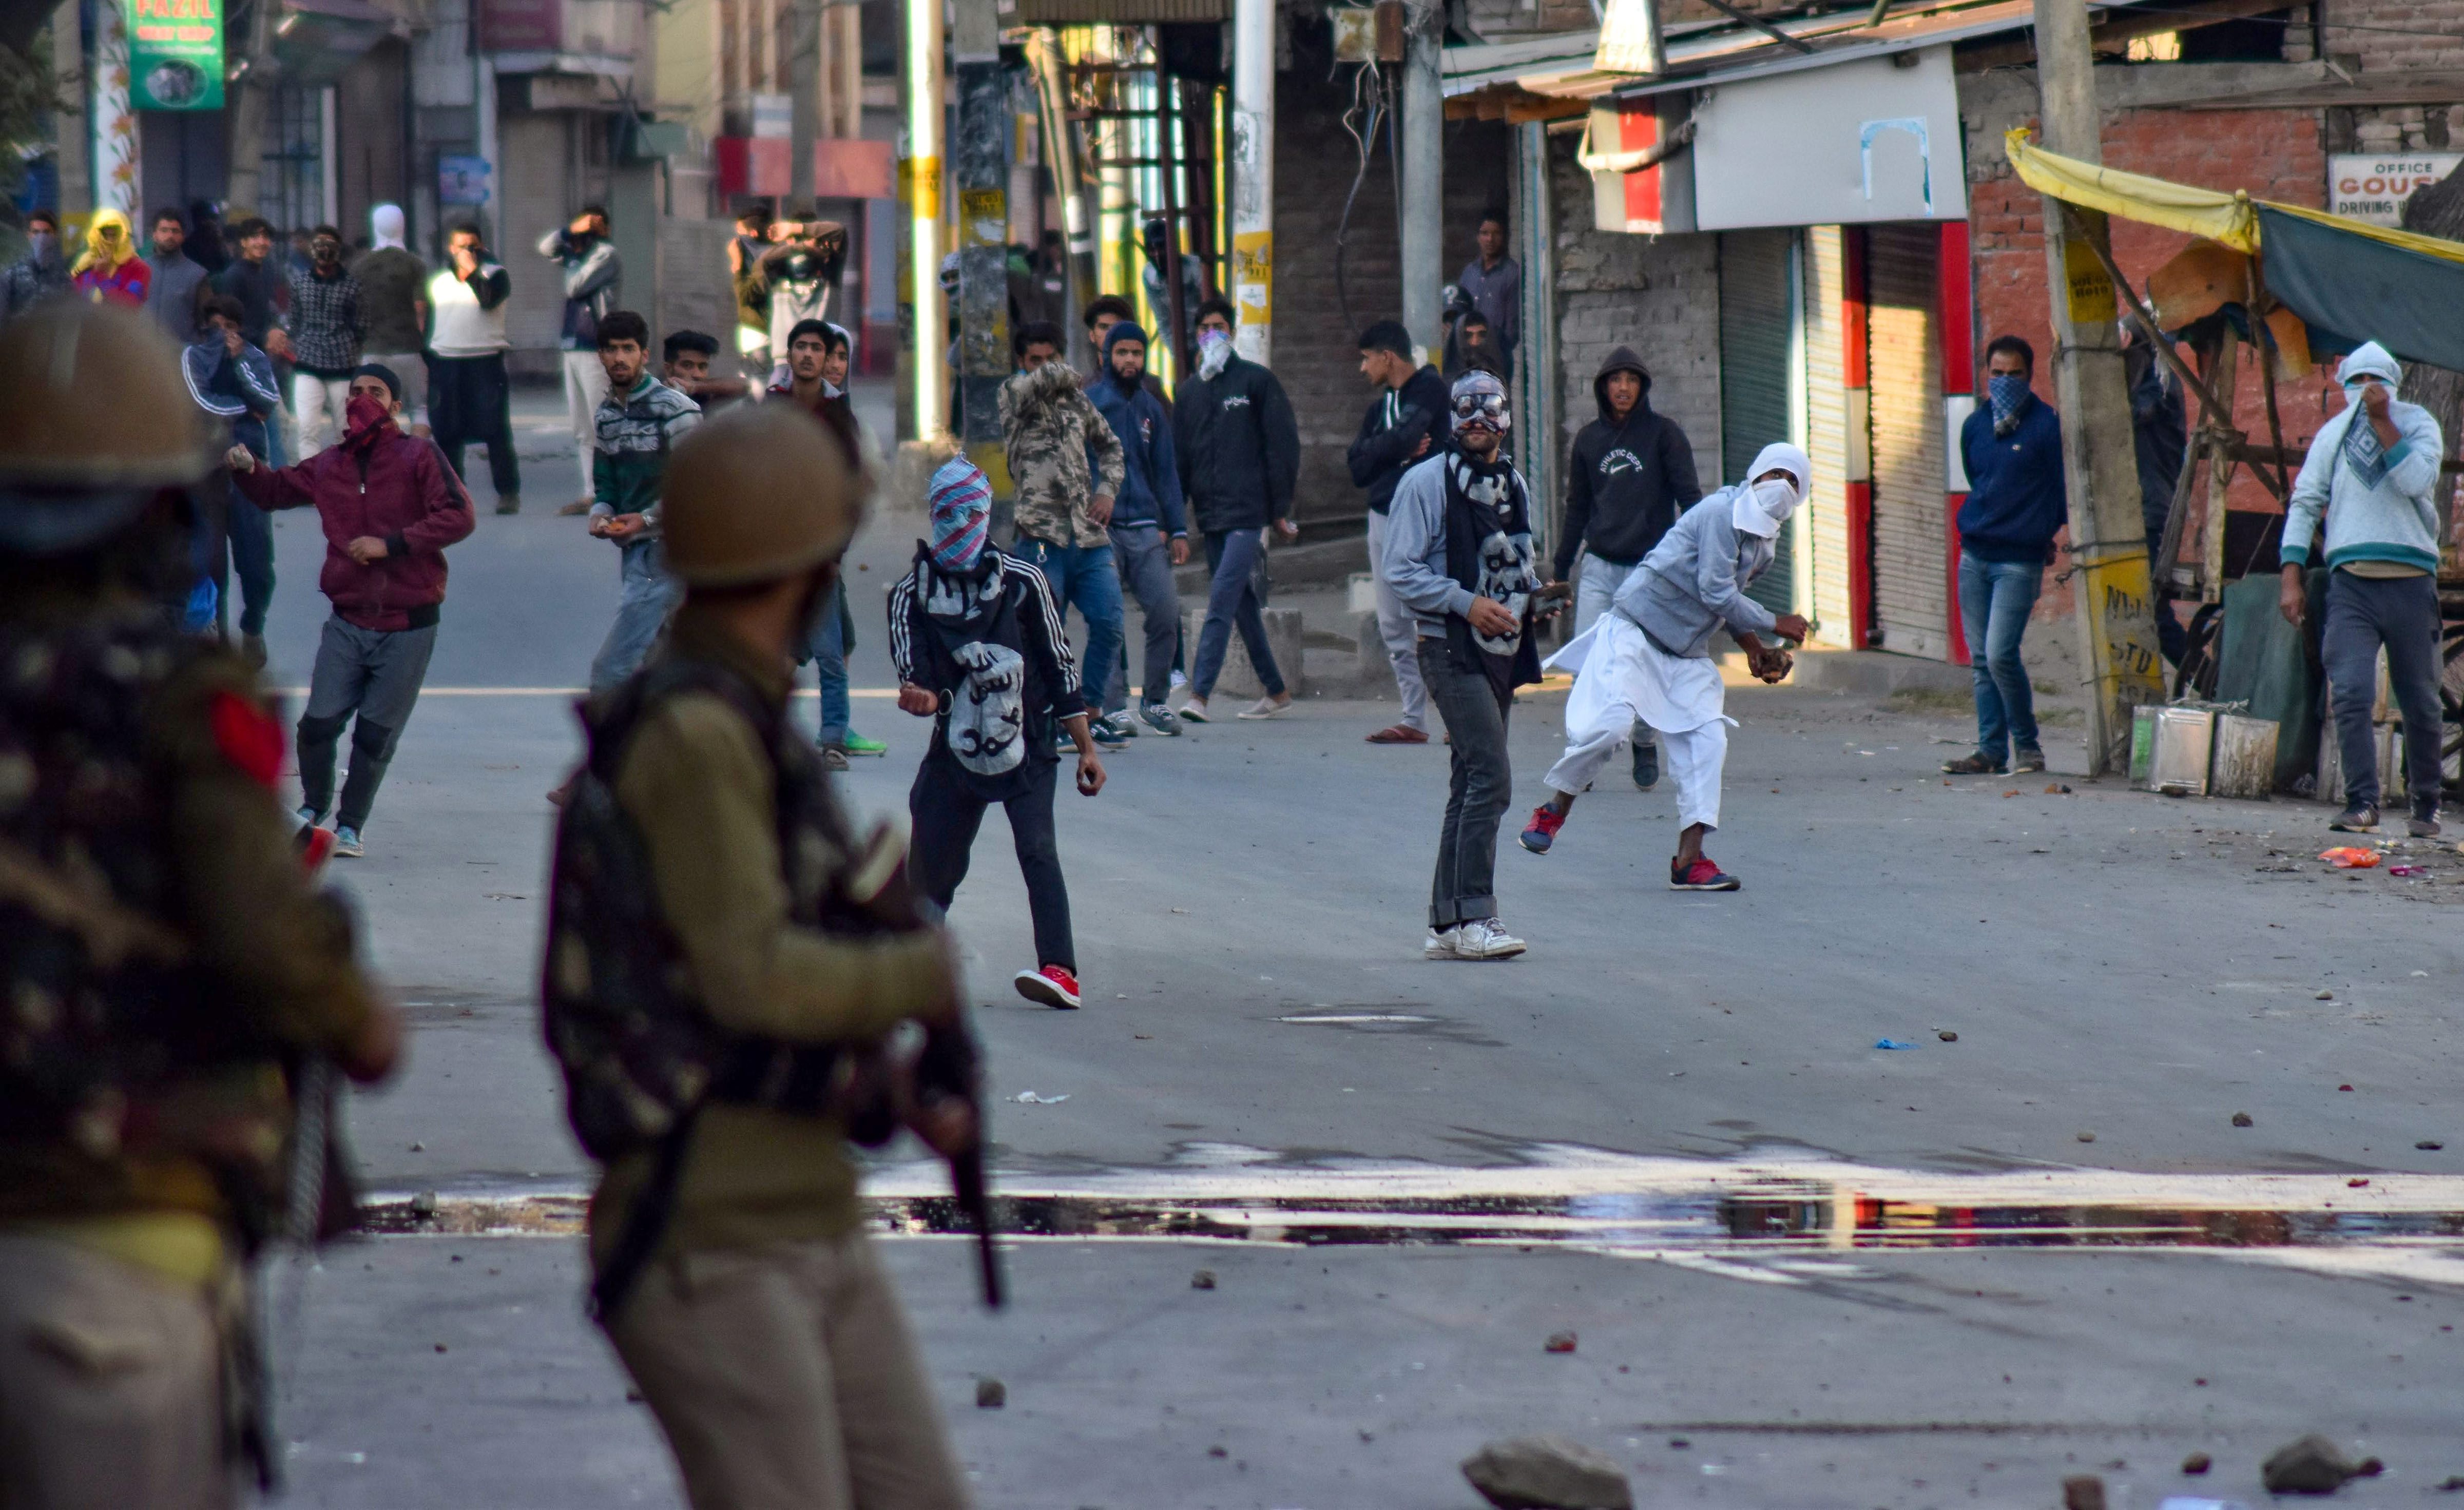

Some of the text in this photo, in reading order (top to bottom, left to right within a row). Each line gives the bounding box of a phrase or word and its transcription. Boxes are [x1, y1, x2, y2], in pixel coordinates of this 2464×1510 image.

[137, 0, 214, 18] FAZIL
[2375, 163, 2432, 173] OFFICE
[2339, 177, 2442, 195] GOU
[2339, 200, 2393, 214] DRIVING
[1600, 449, 1626, 472] ATHLETIC
